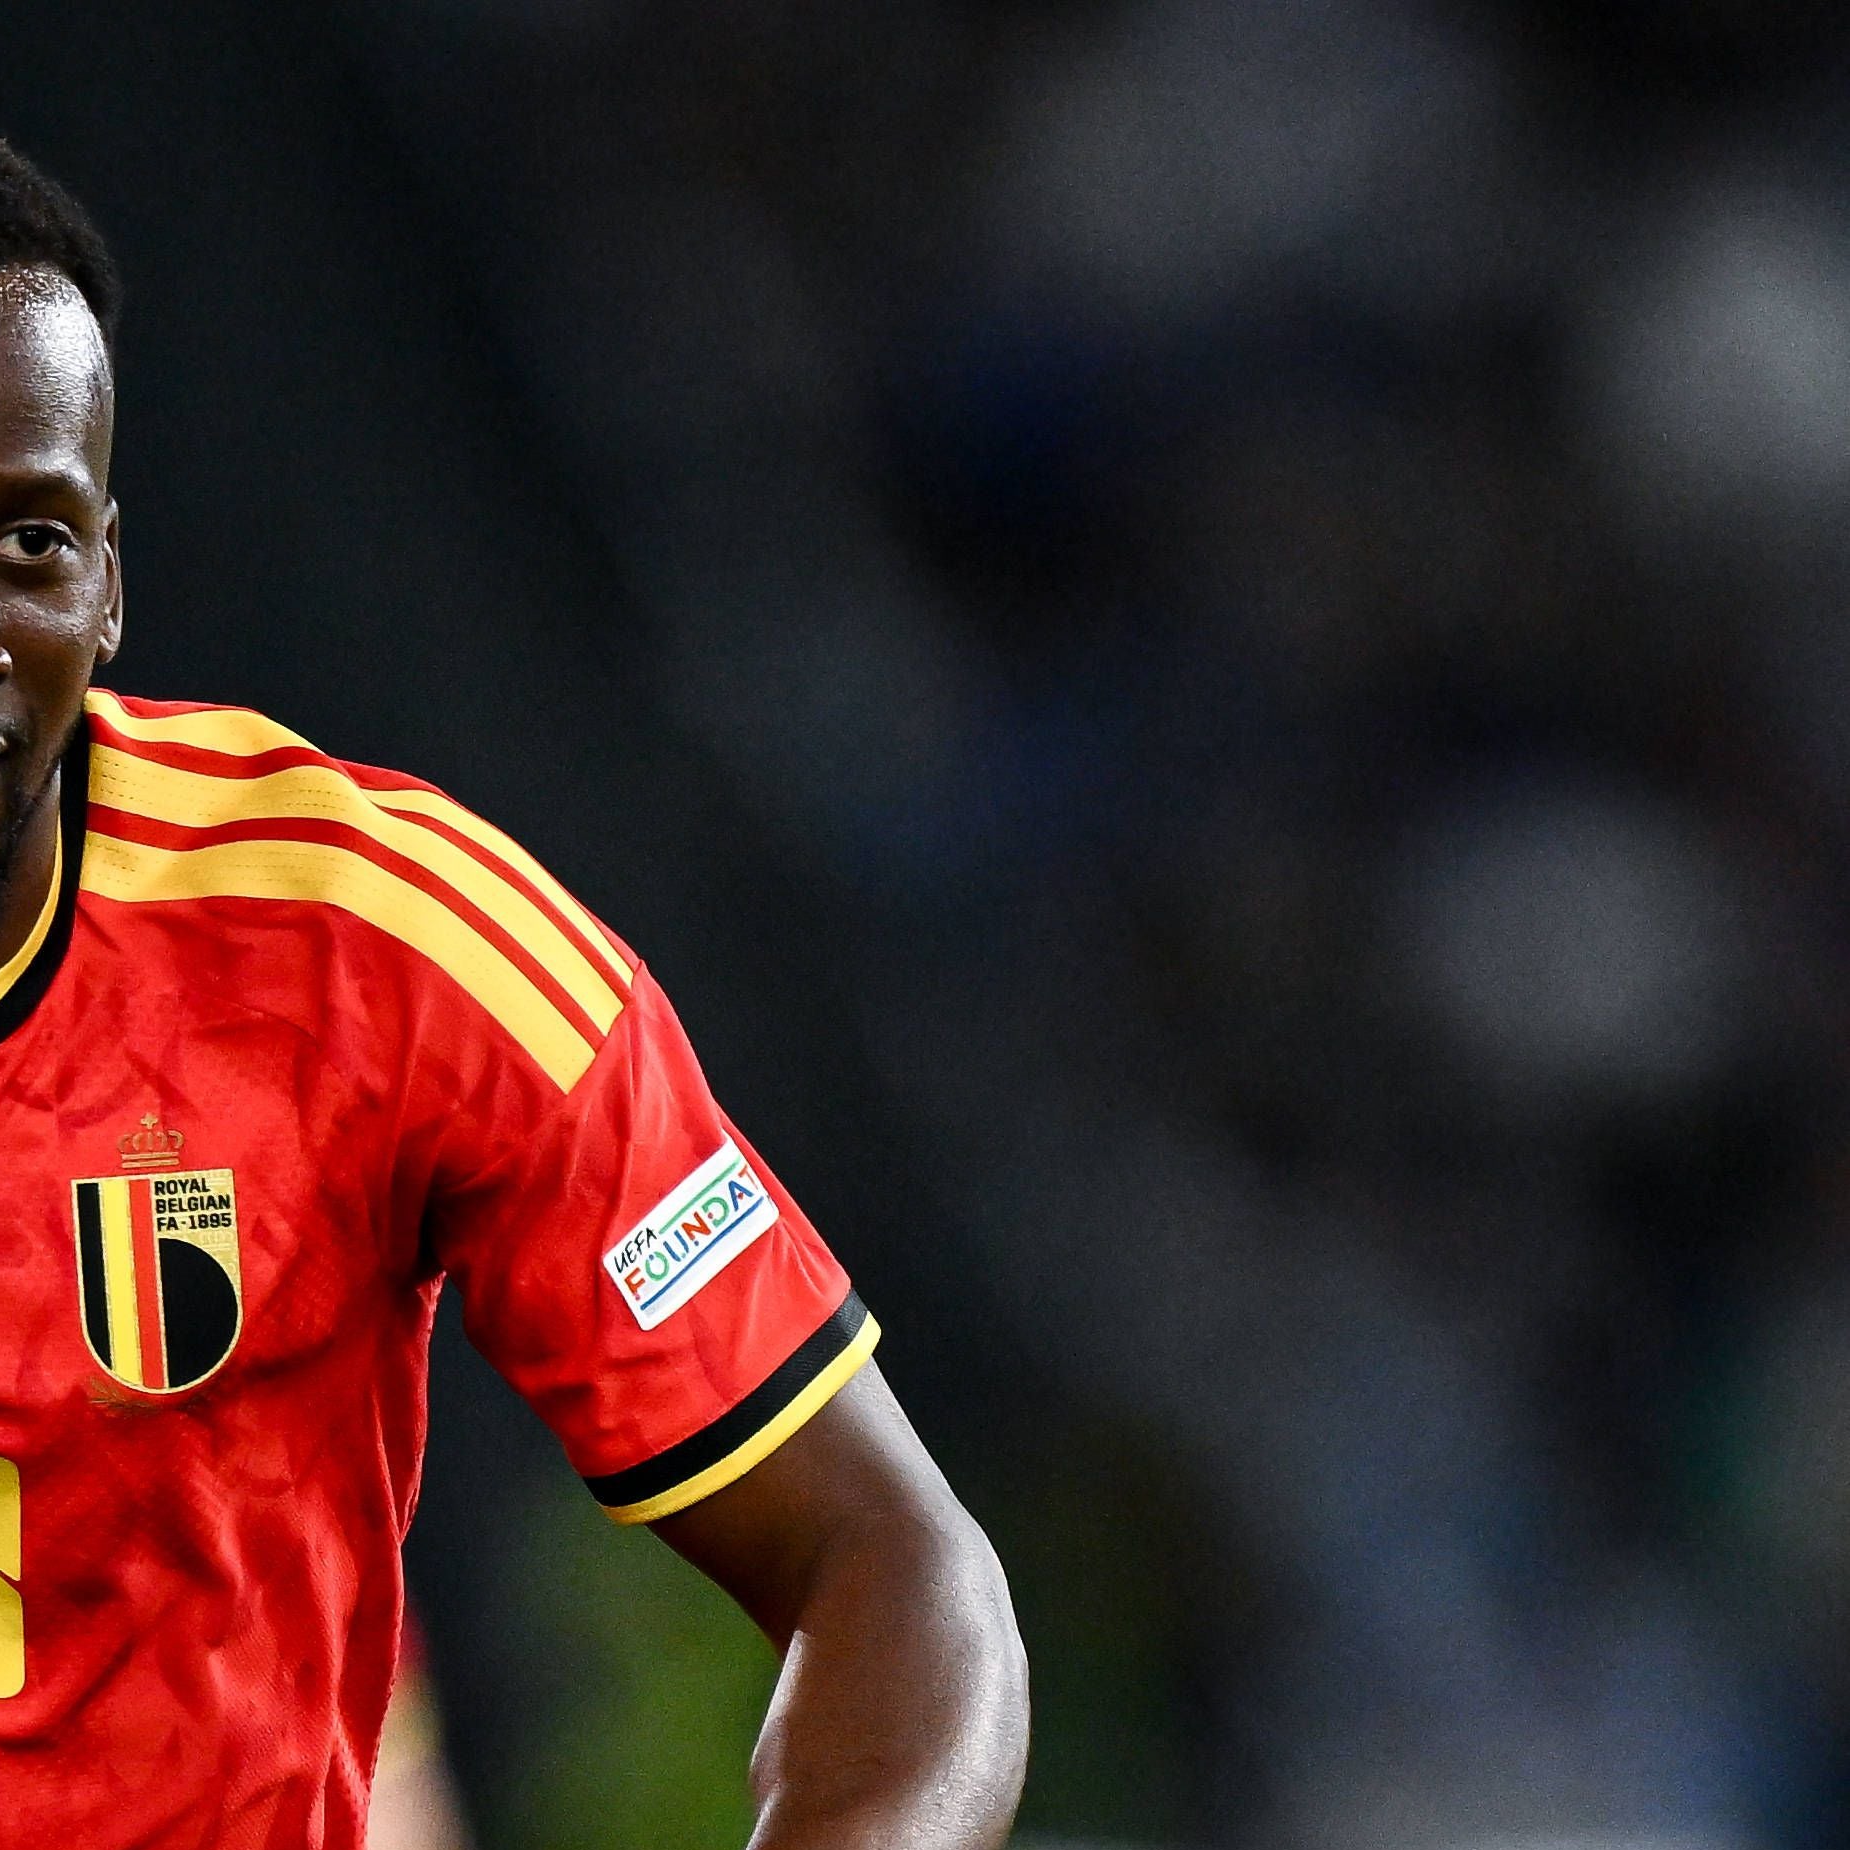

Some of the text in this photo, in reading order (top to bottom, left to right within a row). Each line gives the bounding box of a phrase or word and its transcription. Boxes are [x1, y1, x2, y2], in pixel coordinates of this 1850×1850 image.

[154, 1178, 211, 1196] ROYAL
[155, 1194, 231, 1214] BELGIAN
[613, 1227, 657, 1273] UEFA
